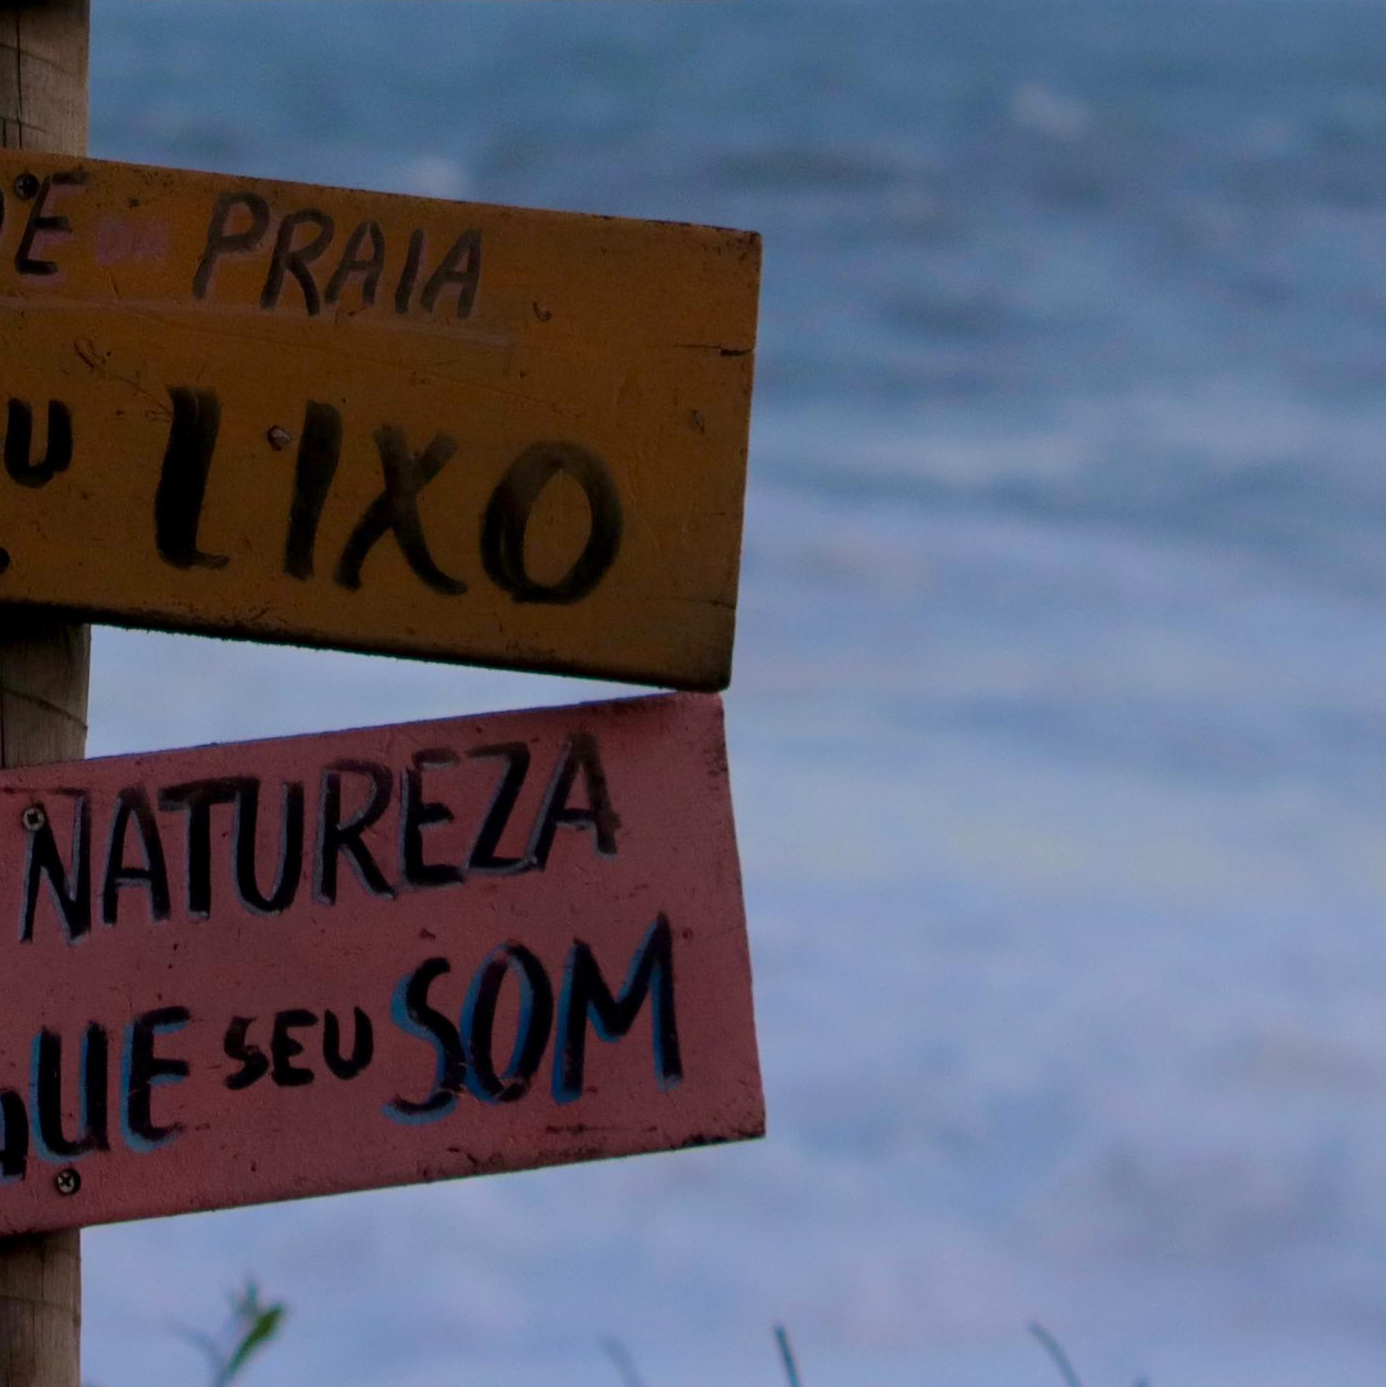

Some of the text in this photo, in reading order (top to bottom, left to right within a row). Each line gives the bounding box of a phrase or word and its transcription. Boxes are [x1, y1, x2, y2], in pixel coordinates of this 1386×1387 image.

[191, 190, 484, 318] PRAIA
[153, 383, 626, 606] LIXO
[16, 730, 622, 947] NATUREZA
[222, 1006, 376, 1091] SEU
[380, 910, 686, 1126] SOM
